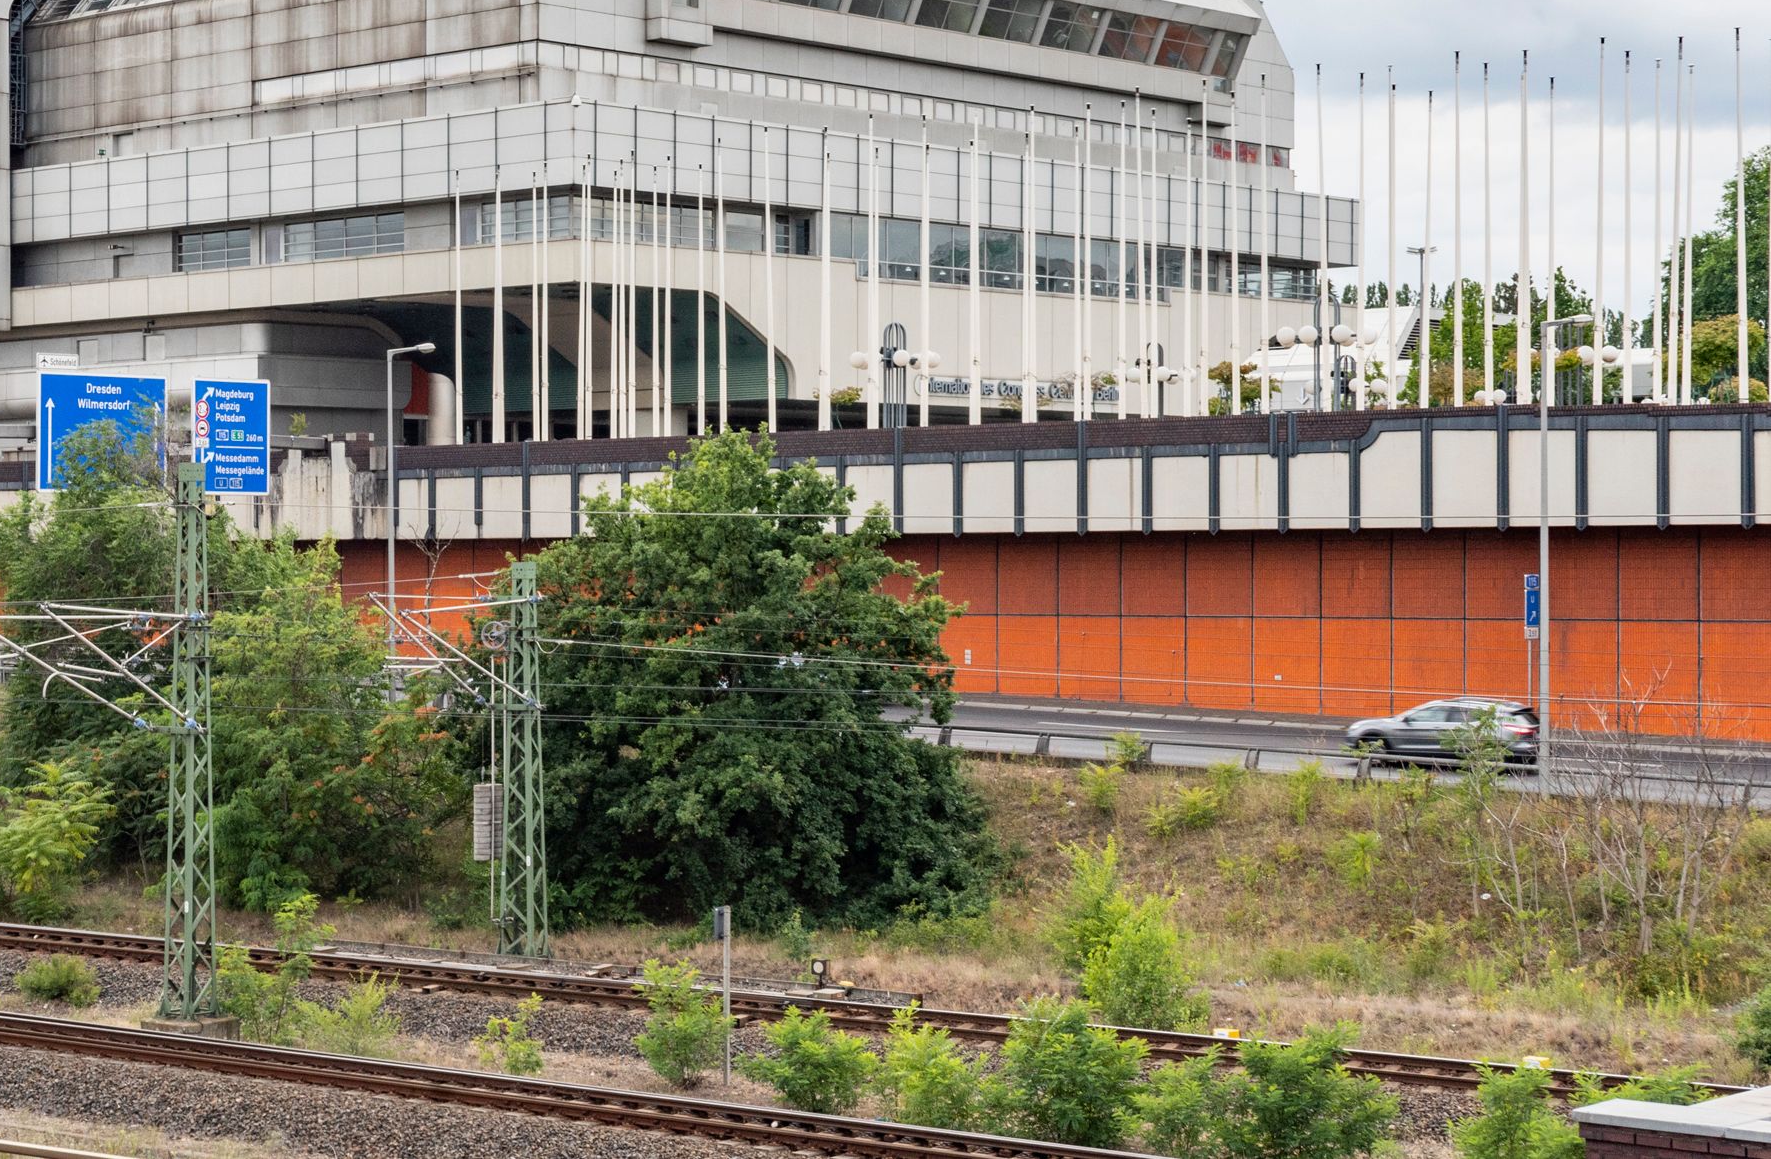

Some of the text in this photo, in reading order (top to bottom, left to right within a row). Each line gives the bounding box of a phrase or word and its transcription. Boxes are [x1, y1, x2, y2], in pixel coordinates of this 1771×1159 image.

[86, 383, 122, 395] Dresden
[215, 388, 254, 401] Magdeburg
[77, 398, 130, 410] Wilmersdorf
[215, 401, 240, 412] Leipzig
[215, 412, 245, 422] Potsdam
[246, 434, 256, 442] 260
[215, 453, 259, 462] Messedamm
[215, 465, 264, 476] Messegelände
